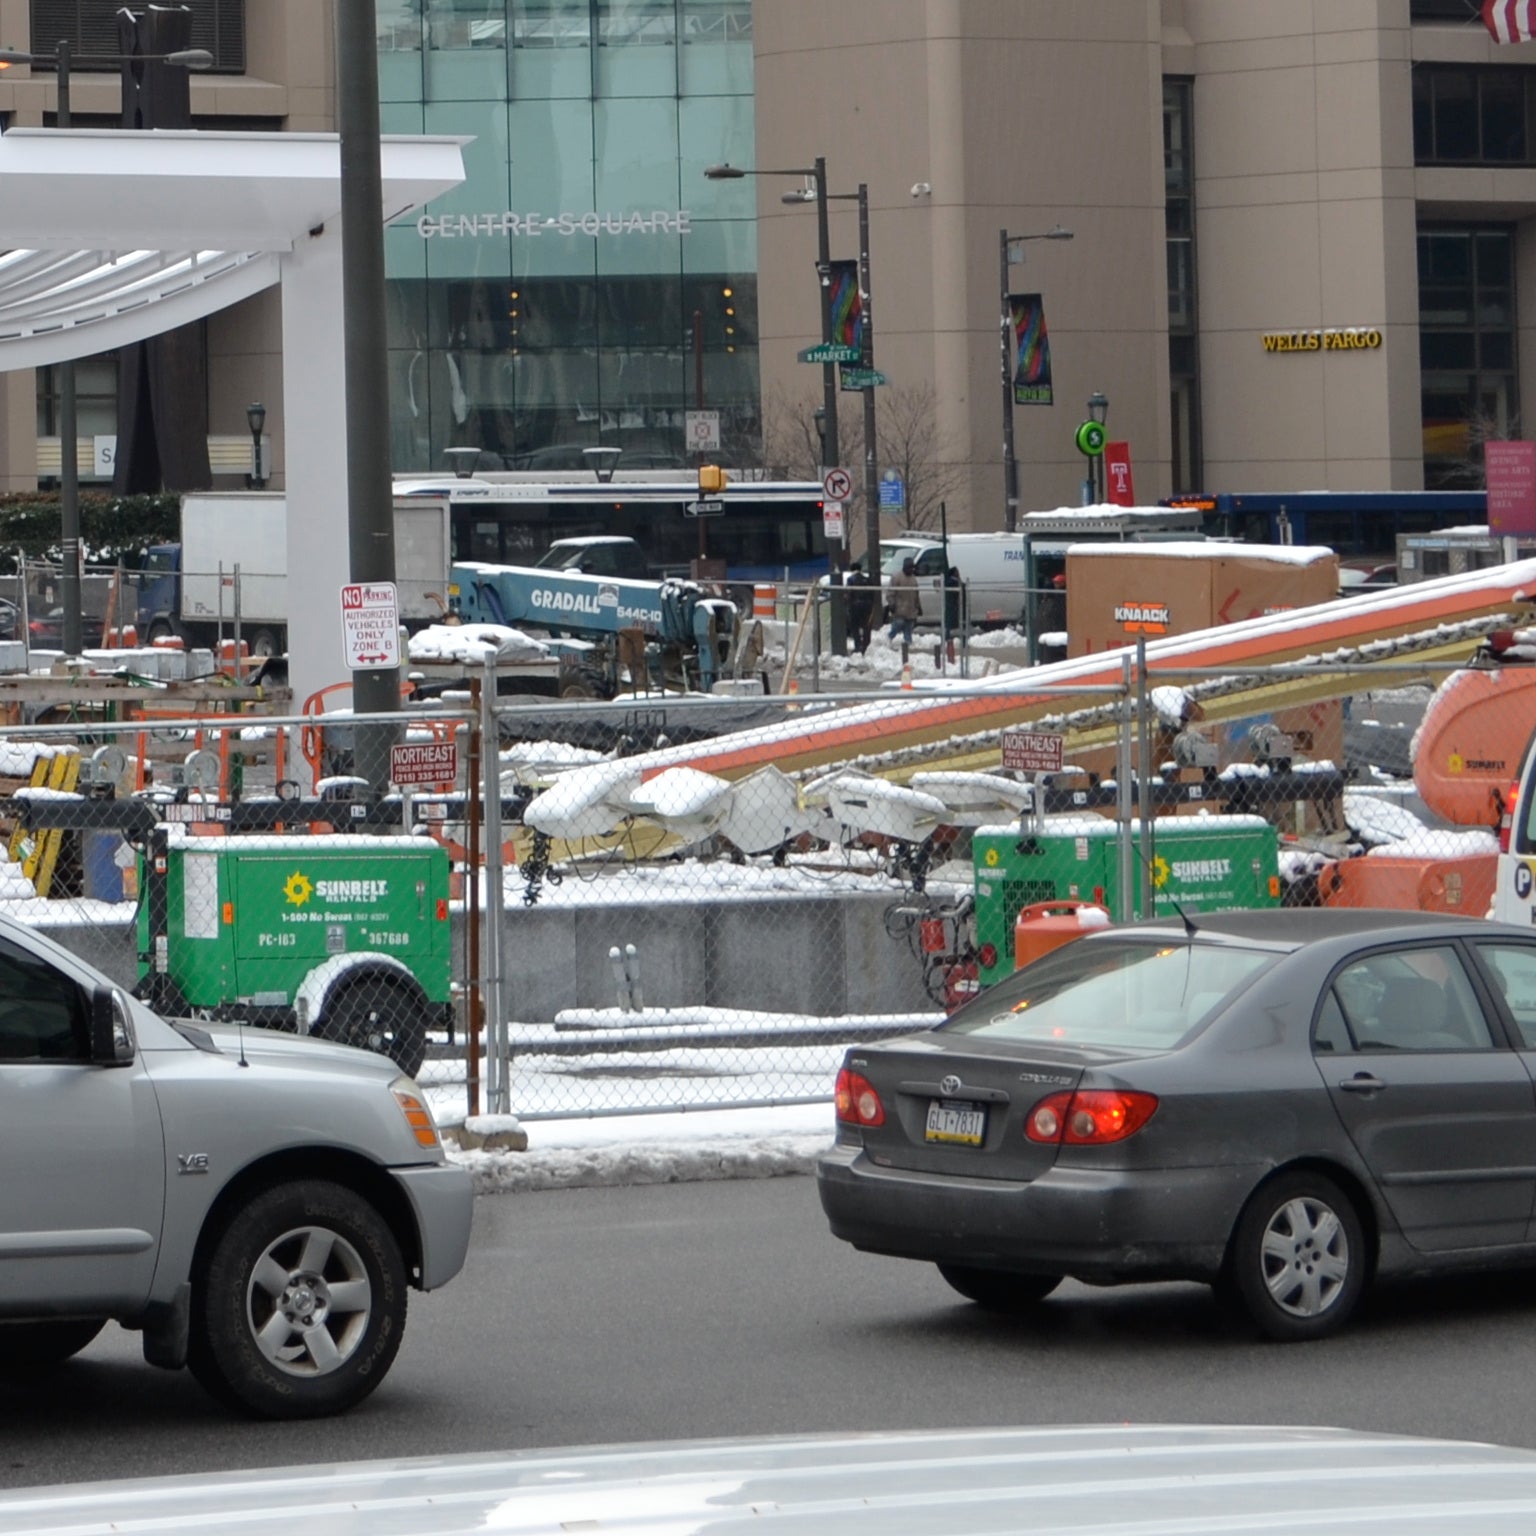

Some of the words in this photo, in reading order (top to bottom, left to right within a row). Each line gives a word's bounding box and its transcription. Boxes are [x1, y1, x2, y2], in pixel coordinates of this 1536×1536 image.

[417, 213, 542, 238] CENTRE
[558, 211, 692, 236] SQUARE
[1262, 332, 1321, 352] WELLS
[1323, 329, 1382, 350] FARGO
[814, 350, 851, 361] MARKET
[343, 589, 360, 606] NO
[363, 591, 392, 602] PARKING
[531, 589, 600, 613] GRADALL
[346, 610, 394, 619] AUTHORIZED
[1115, 607, 1169, 623] KNAACK
[348, 620, 393, 630] VEHICLES
[356, 631, 385, 639] ONLY
[352, 642, 380, 651] ZONE
[385, 641, 392, 650] B
[1004, 735, 1061, 752] NORTHEAST
[394, 746, 454, 764] NORTHEAST
[395, 773, 416, 783] (215)
[1173, 860, 1230, 877] SUNBELT
[1180, 875, 1223, 883] RENTALS
[1518, 869, 1530, 892] P
[315, 880, 388, 896] SUNBELT
[326, 895, 377, 903] RENTALS
[282, 913, 308, 922] 1-800
[309, 912, 323, 922] No
[324, 911, 353, 922] Sweat
[178, 1154, 208, 1168] V8
